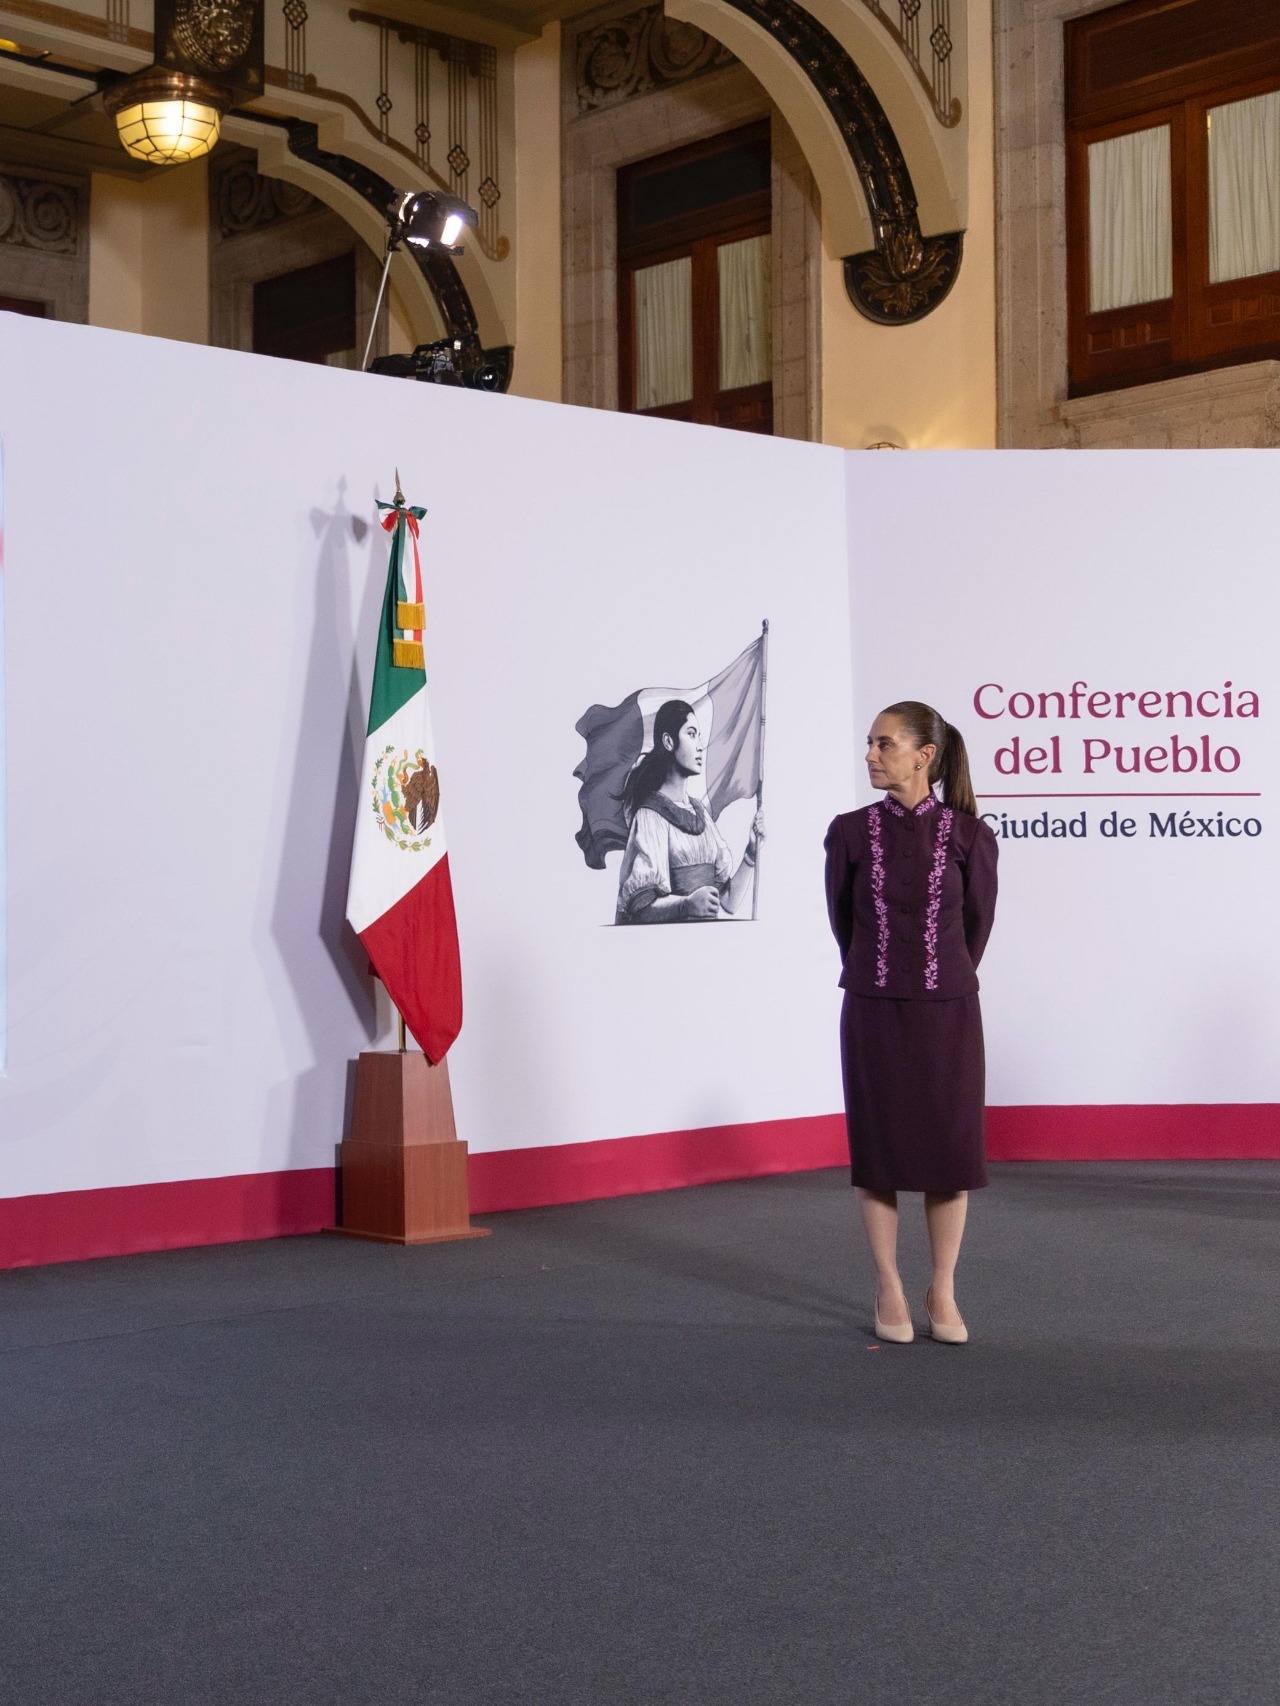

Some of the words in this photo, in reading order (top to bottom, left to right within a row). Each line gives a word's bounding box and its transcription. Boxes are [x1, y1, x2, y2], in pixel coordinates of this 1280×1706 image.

[973, 681, 1260, 719] Conferencia
[994, 736, 1062, 775] del
[1083, 734, 1241, 774] Pueblo
[980, 811, 1087, 839] Ciudad
[1099, 811, 1137, 838] de
[1149, 810, 1262, 838] México
